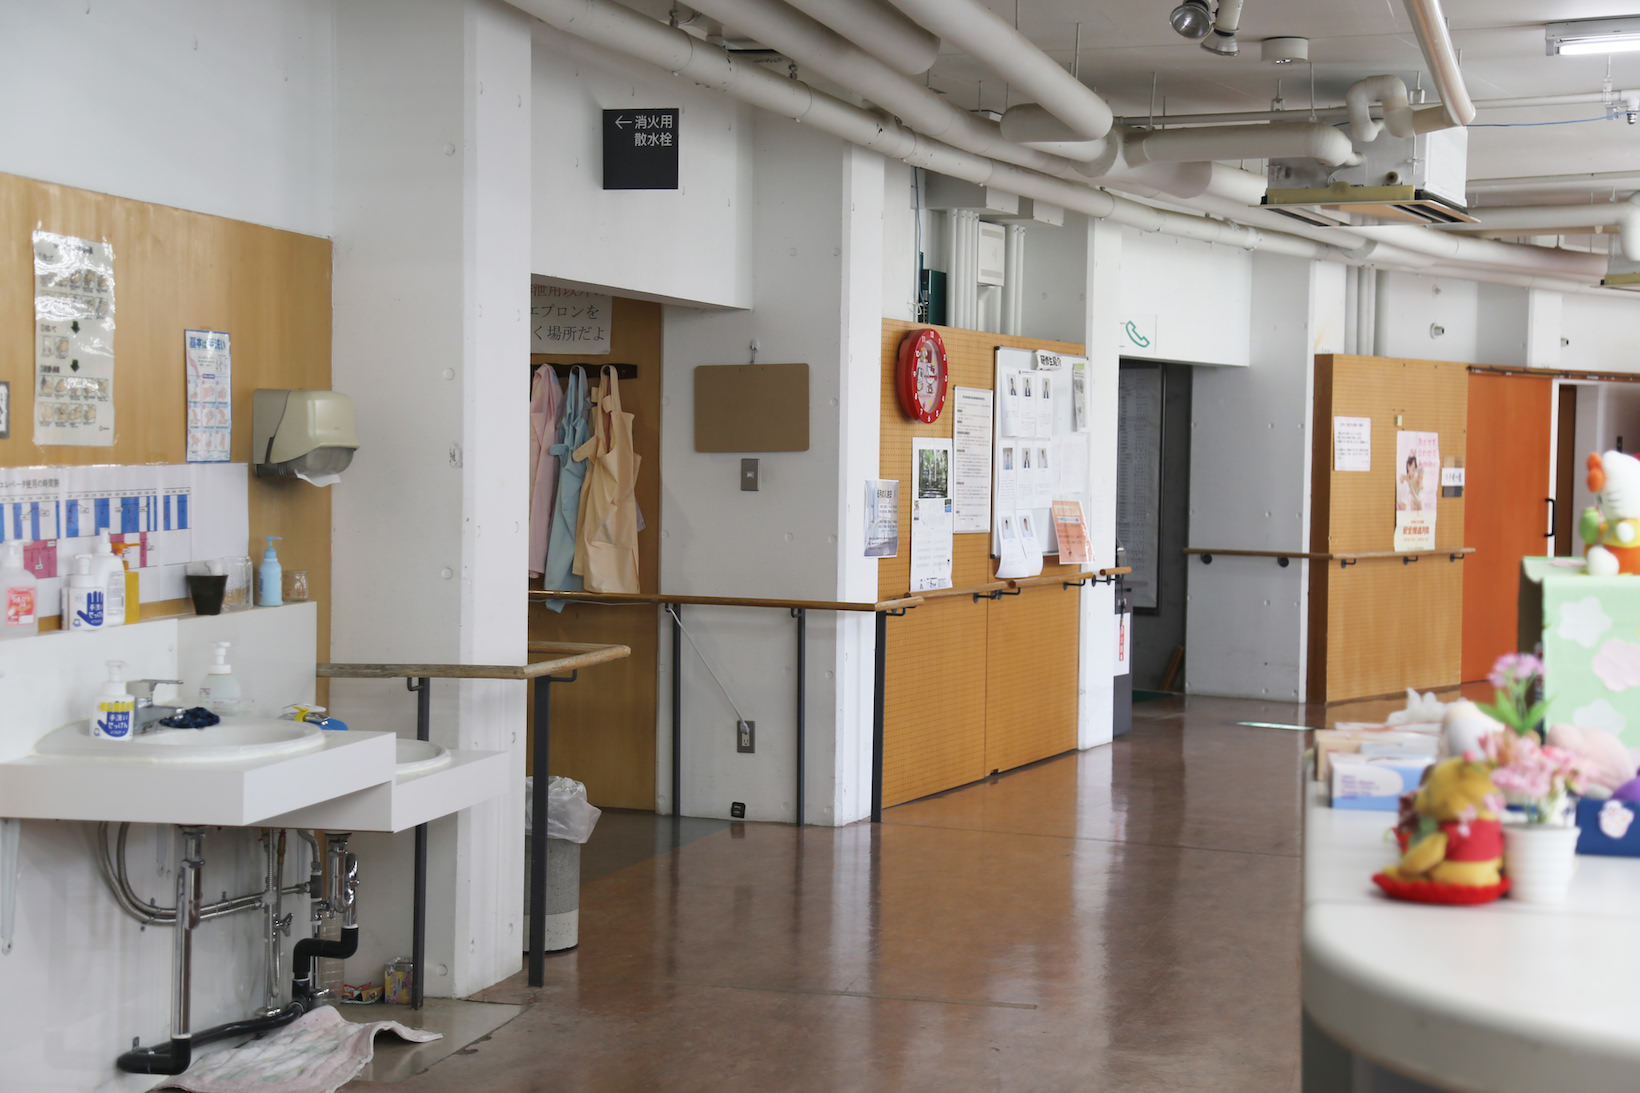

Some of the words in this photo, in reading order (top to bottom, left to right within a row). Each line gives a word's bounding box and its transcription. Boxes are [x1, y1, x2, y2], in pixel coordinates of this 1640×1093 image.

[634, 115, 673, 129] 消火用
[634, 132, 673, 147] 散水栓
[534, 325, 605, 342] く場所だよ
